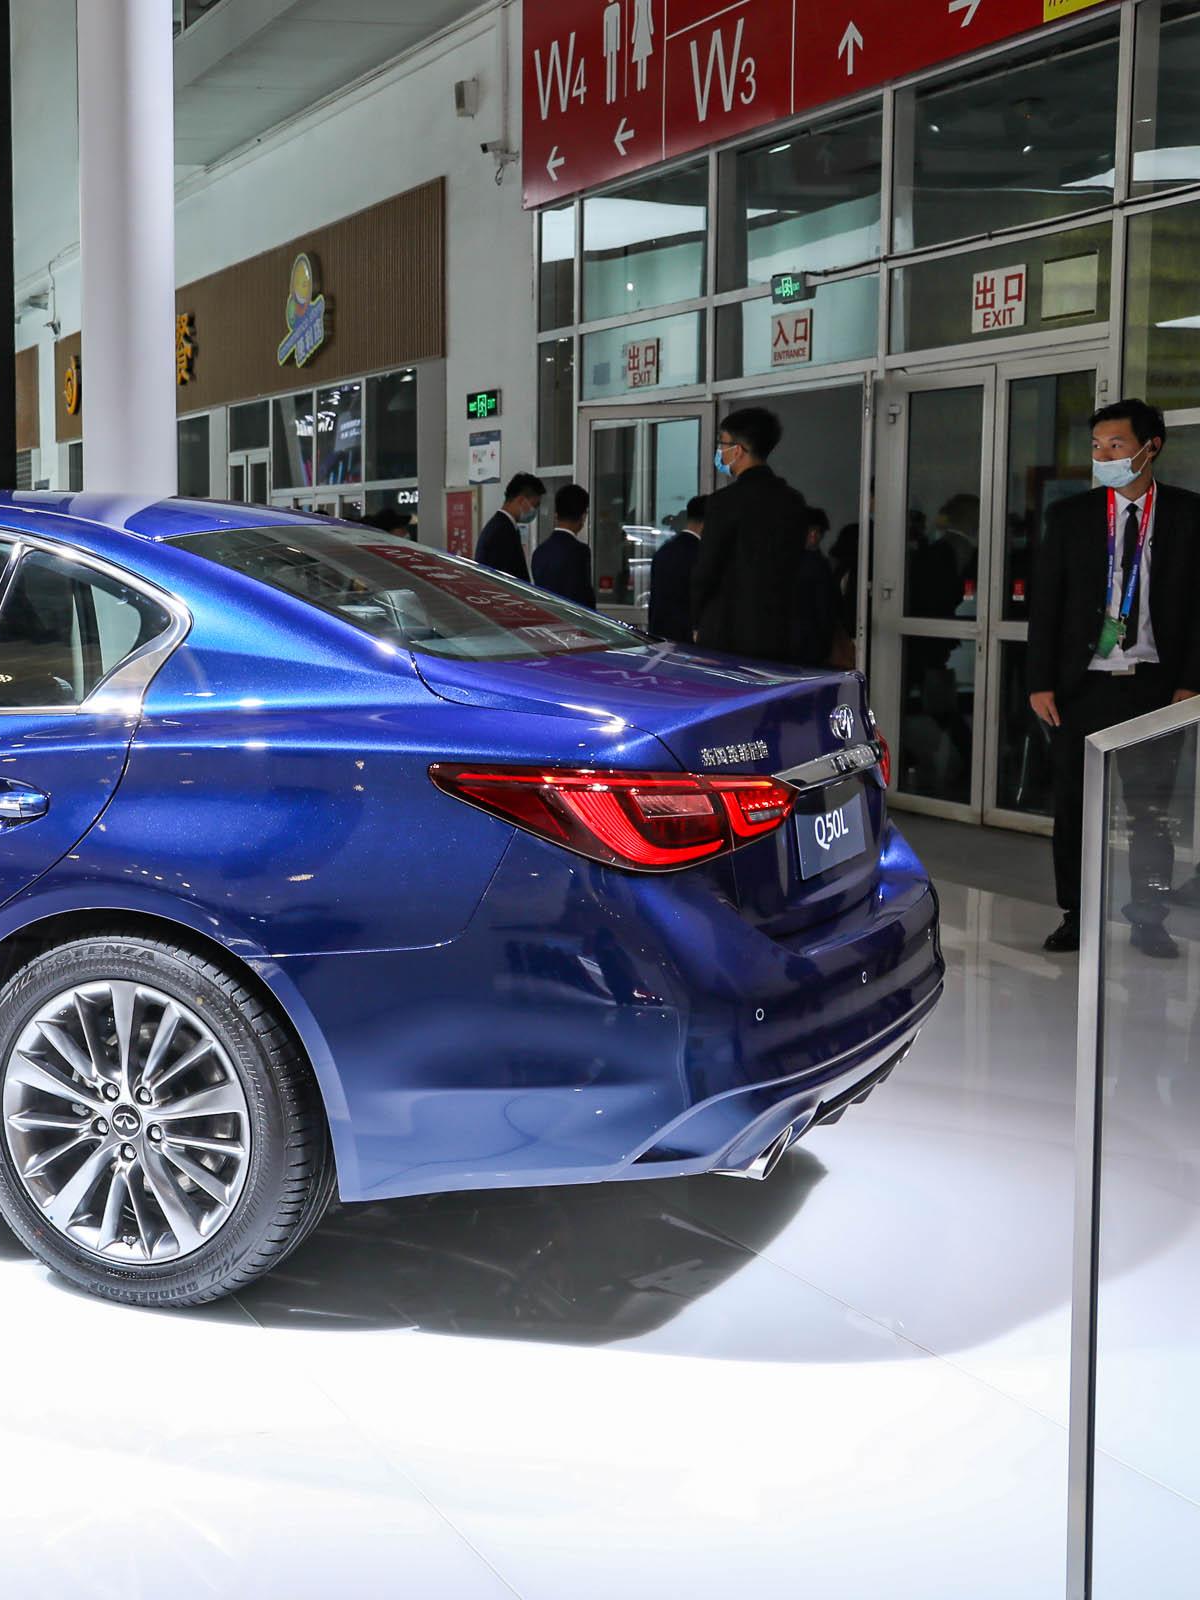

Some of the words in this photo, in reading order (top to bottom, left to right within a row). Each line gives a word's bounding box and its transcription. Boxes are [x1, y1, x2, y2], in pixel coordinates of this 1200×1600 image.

[534, 31, 587, 121] W4
[690, 17, 757, 122] W3
[975, 273, 1023, 310] 出口
[773, 318, 808, 347] 入口
[983, 307, 1016, 329] EXIT
[628, 345, 656, 371] 出口
[774, 347, 807, 361] ENTRANCE
[632, 370, 651, 386] EXIT
[815, 808, 849, 850] Q50L
